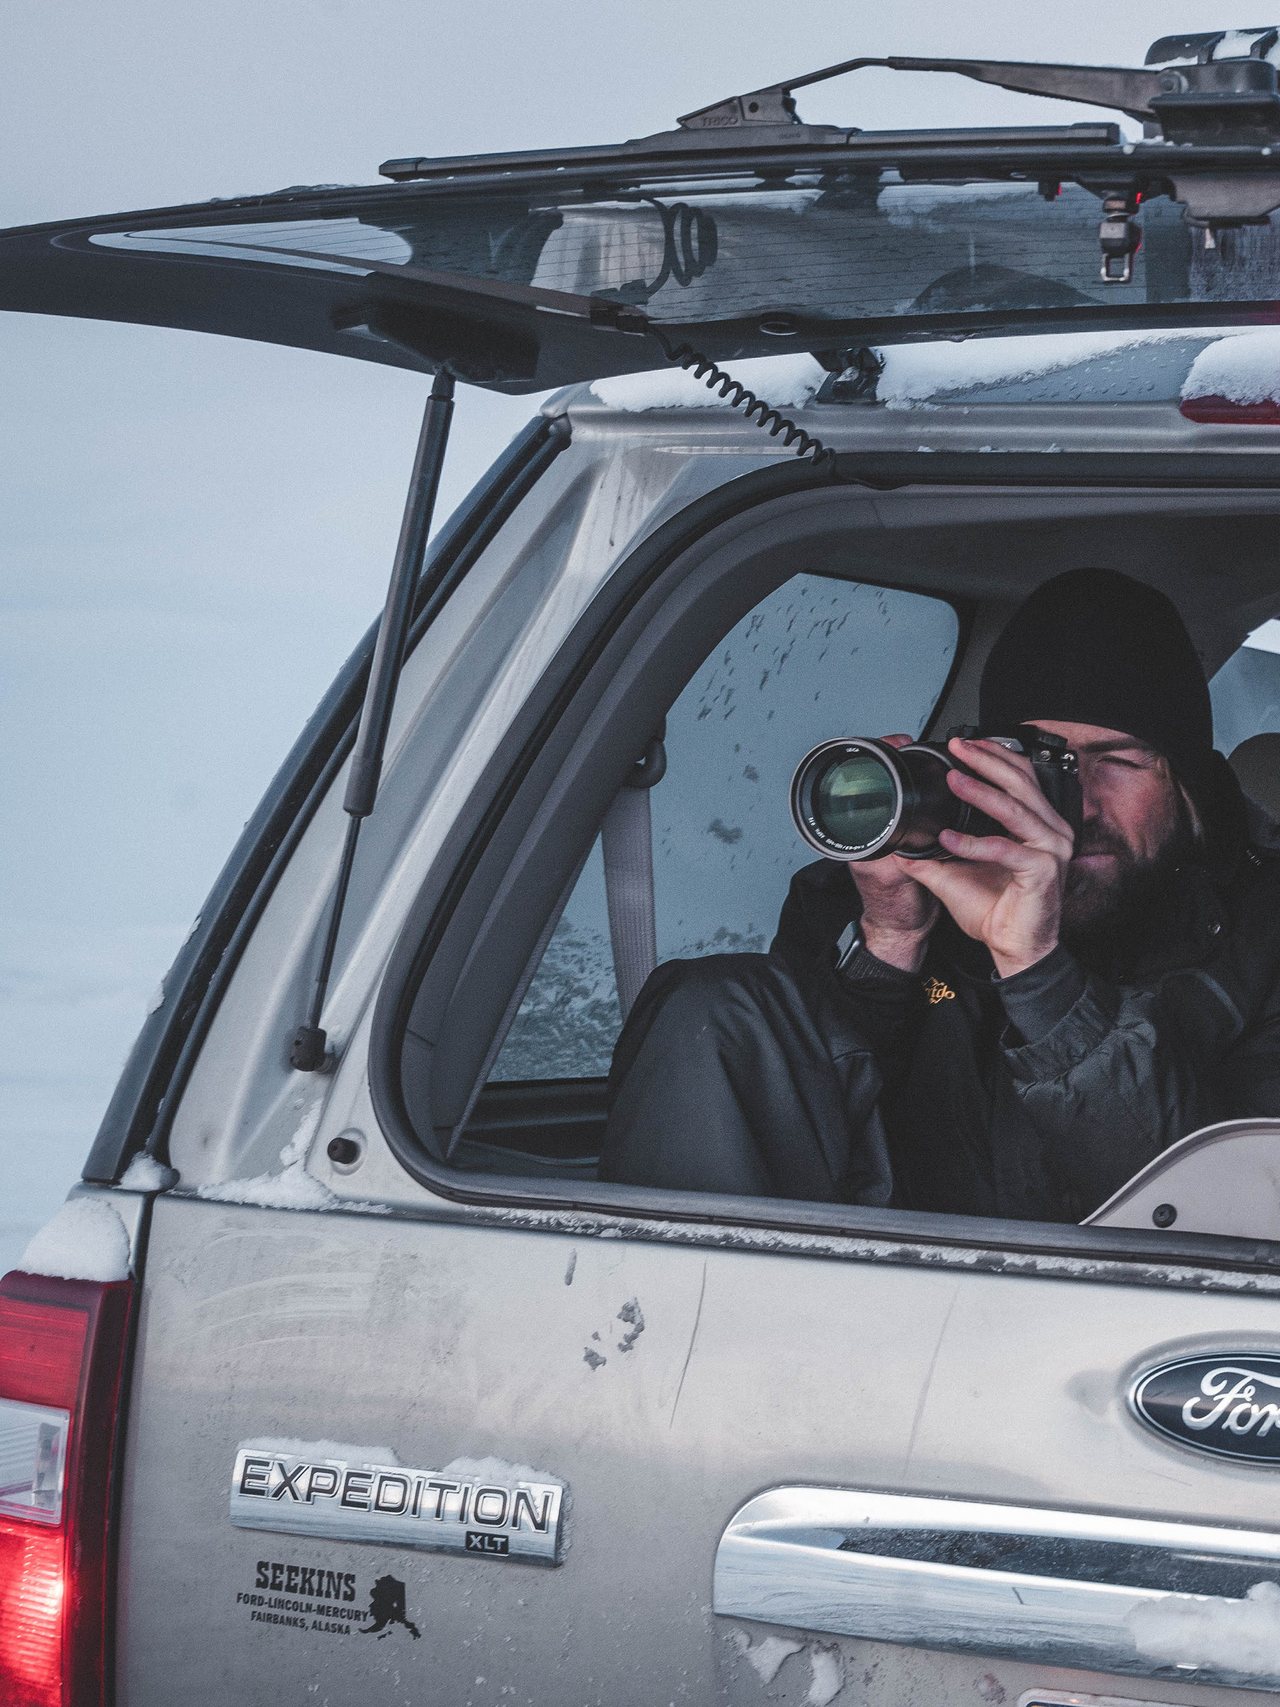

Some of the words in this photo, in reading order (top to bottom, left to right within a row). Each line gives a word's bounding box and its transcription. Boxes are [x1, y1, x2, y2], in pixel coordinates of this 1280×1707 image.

[239, 1455, 555, 1534] EXPEDITION
[469, 1534, 507, 1552] XLT
[255, 1560, 356, 1602] SEEKINS
[236, 1592, 369, 1622] FORD-LINCOLN-MERCURY
[250, 1610, 310, 1632] FAIRBANKS,
[311, 1620, 351, 1636] ALASKA
